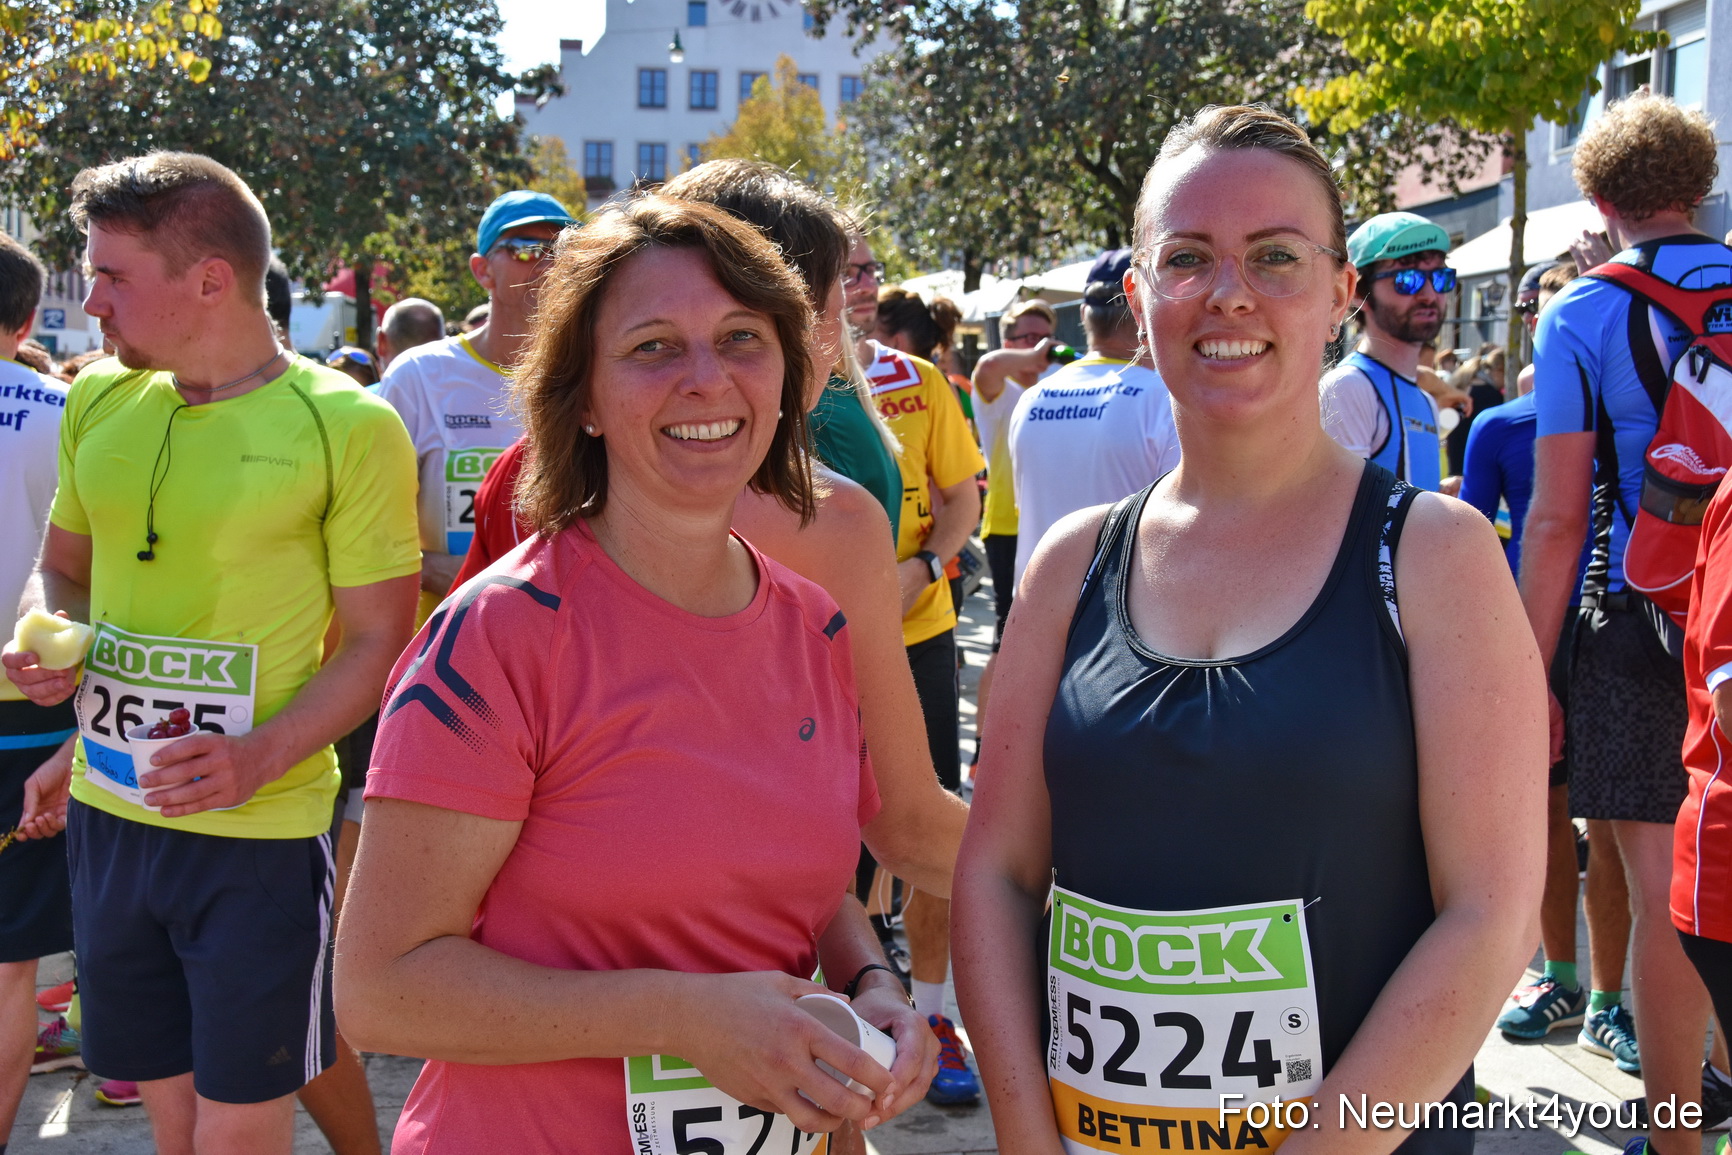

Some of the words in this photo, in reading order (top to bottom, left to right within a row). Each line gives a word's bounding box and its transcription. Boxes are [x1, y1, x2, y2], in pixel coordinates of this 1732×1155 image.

[1386, 235, 1439, 253] Bianchi
[0, 384, 66, 408] rkter
[1038, 382, 1144, 398] Neumarkter
[877, 394, 928, 421] ÖGL
[1028, 402, 1110, 422] Stadtlauf
[93, 630, 237, 688] BOCK
[90, 684, 227, 743] 265
[1061, 903, 1284, 985] BOCK
[1287, 1013, 1302, 1029] S
[1066, 991, 1282, 1090] 5224
[1078, 1102, 1270, 1151] BETTINA
